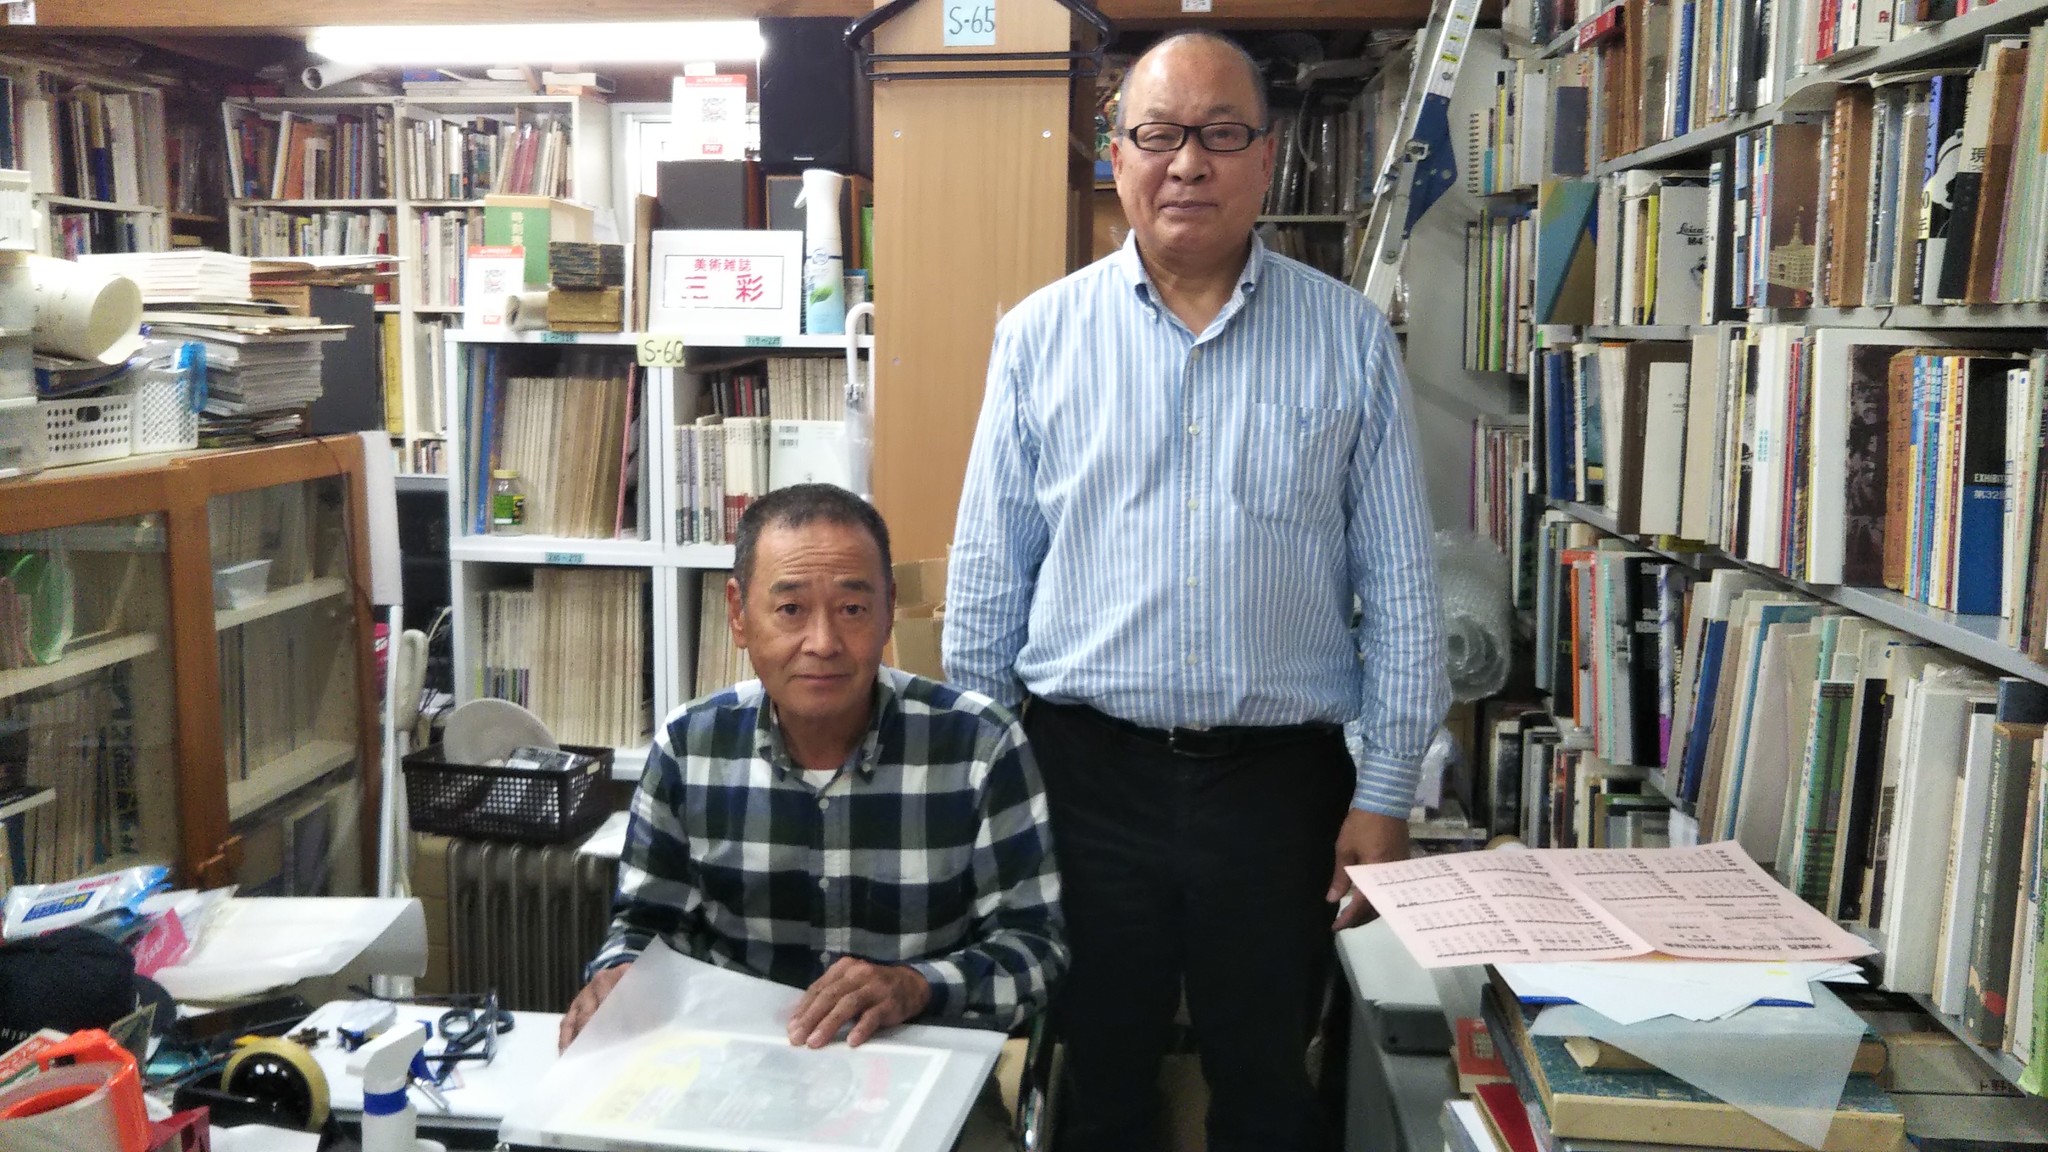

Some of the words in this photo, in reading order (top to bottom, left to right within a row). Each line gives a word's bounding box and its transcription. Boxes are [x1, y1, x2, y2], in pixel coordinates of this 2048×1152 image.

[949, 6, 996, 35] S-65
[694, 258, 752, 272] 美術雑誌
[644, 340, 684, 363] S-60
